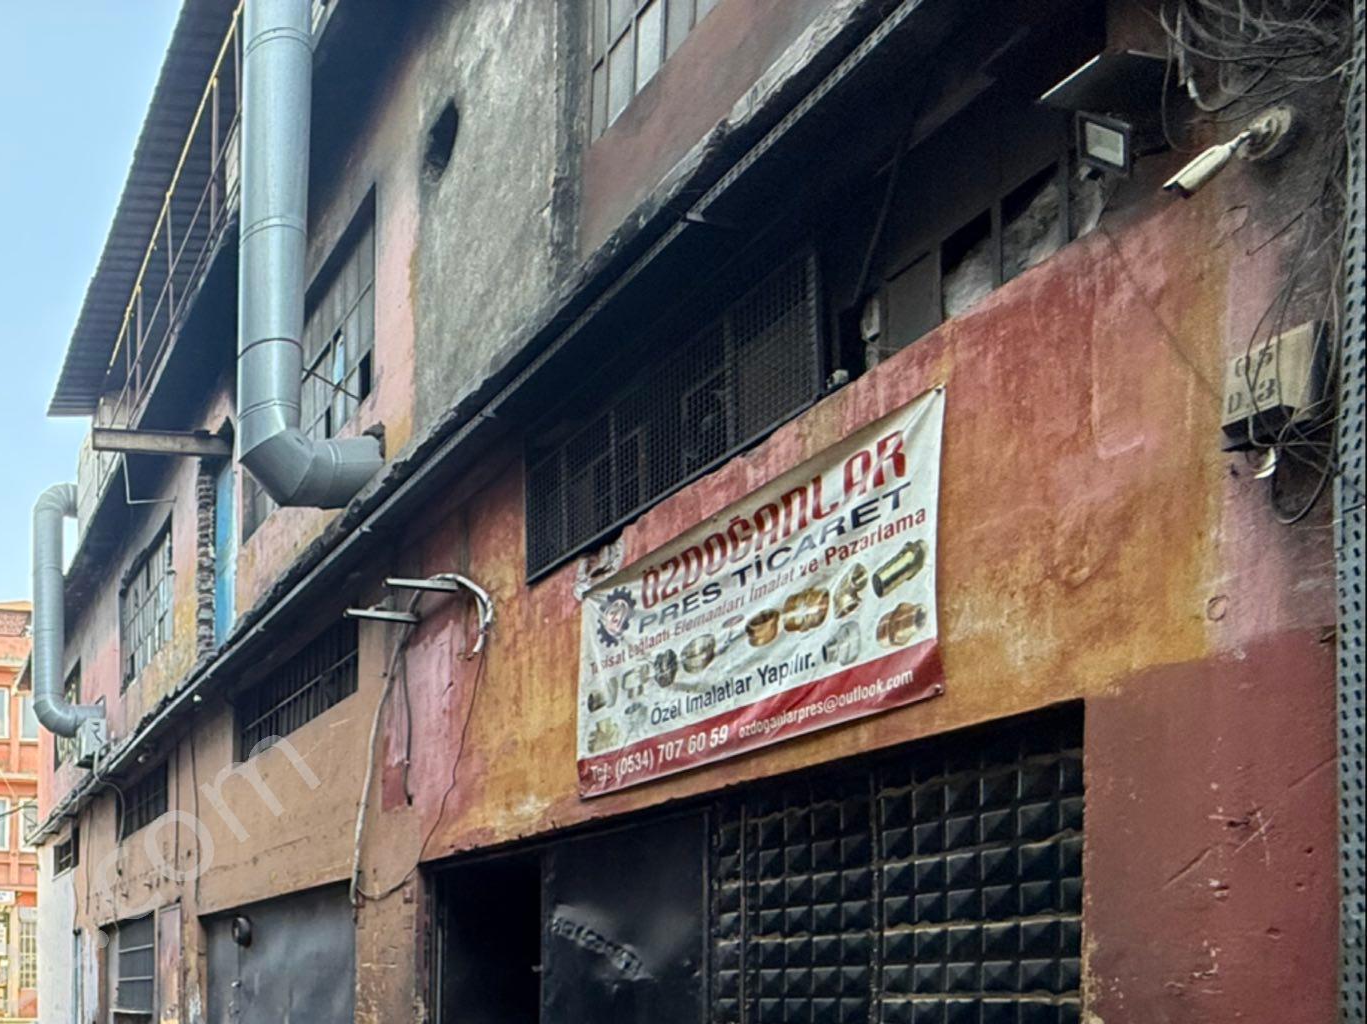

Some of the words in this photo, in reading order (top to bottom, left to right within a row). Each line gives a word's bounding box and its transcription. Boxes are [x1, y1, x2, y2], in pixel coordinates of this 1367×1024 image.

[641, 430, 906, 609] ÖZDOĞANLAR
[825, 508, 926, 566] Pazarlama
[638, 582, 722, 633] PRES
[731, 482, 911, 589] TİCARET
[651, 699, 682, 726] Özel
[615, 748, 654, 782] (0534)
[657, 739, 684, 763] 707
[687, 732, 707, 755] 60
[709, 724, 729, 748] 59
